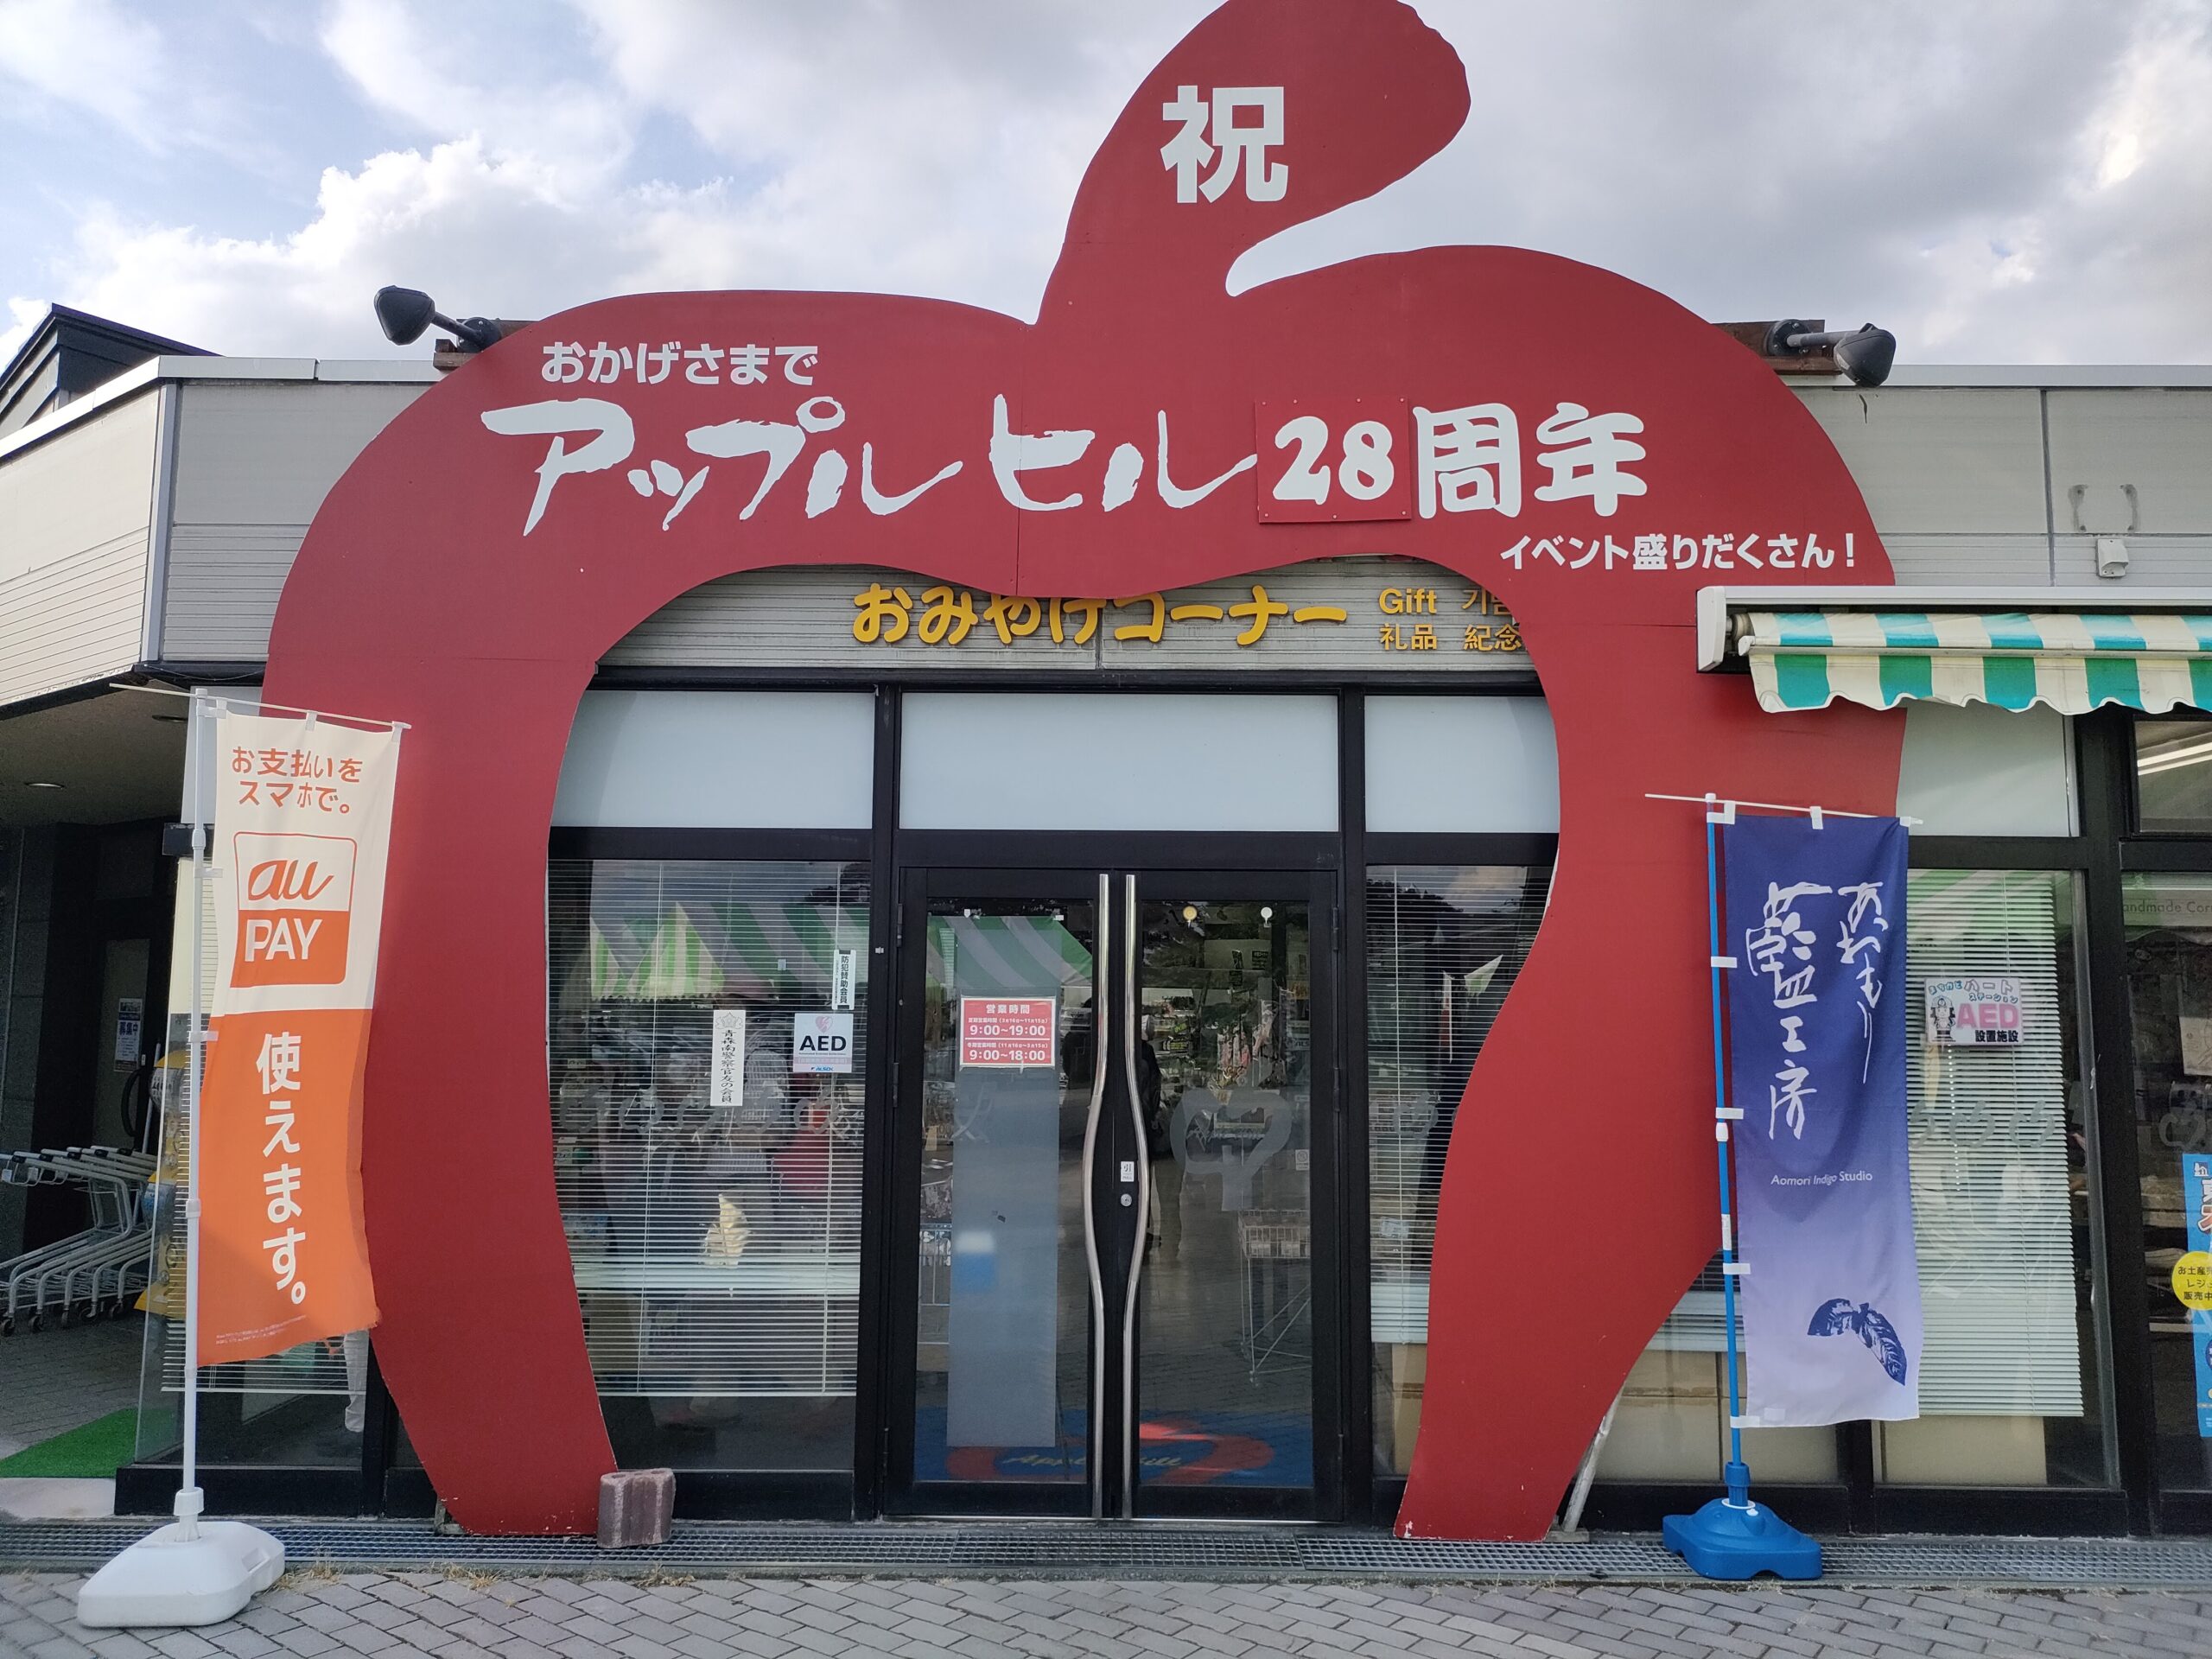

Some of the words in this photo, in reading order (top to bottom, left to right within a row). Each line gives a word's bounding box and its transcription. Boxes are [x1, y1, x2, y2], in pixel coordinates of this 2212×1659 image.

[1160, 84, 1289, 204] 祝
[541, 340, 819, 385] おかげさまで
[1499, 532, 1856, 571] イベント盛りだくさん！
[1379, 588, 1438, 614] Gift
[1379, 622, 1438, 651] 礼品
[231, 746, 363, 784] お支払いを
[238, 780, 350, 815] スマホで。
[247, 859, 335, 901] au
[2122, 899, 2182, 913] andmade
[244, 917, 323, 963] PAY
[986, 1004, 1030, 1015] 営業時間
[1745, 881, 1834, 1141] 藍工房
[1956, 1002, 2019, 1029] AED
[798, 1035, 847, 1052] AED
[1974, 1029, 2019, 1043] 設置施設
[256, 1031, 307, 1305] 使えます。
[1770, 1174, 1811, 1186] Aomori
[1813, 1174, 1838, 1186] Indigo
[1839, 1170, 1873, 1182] Studio
